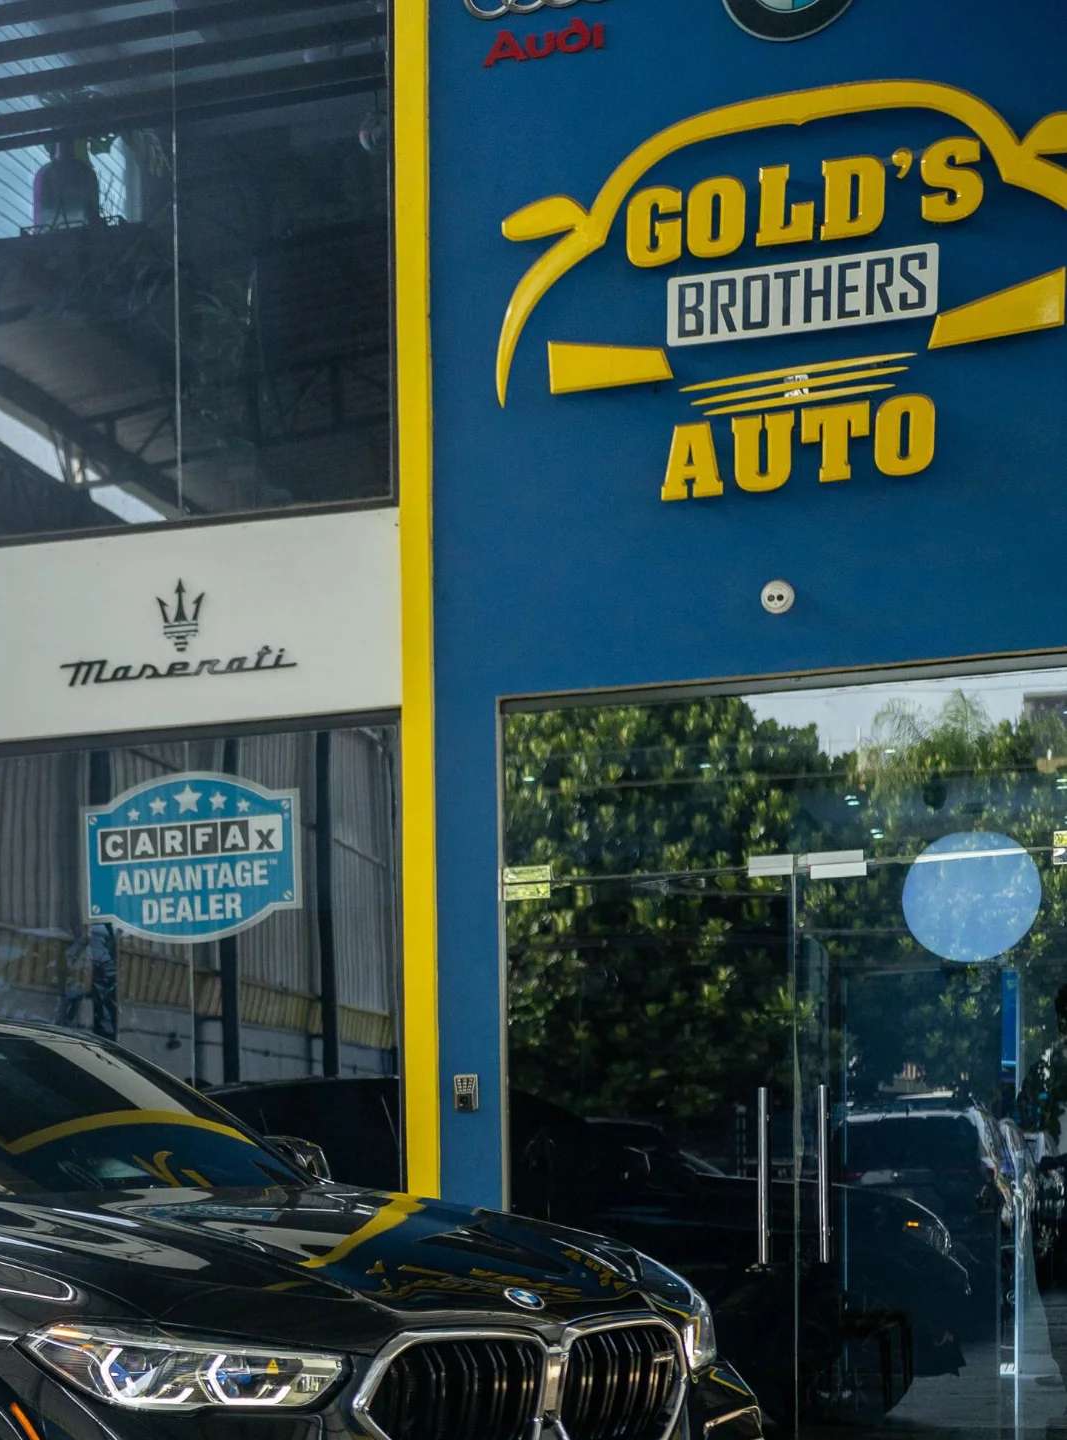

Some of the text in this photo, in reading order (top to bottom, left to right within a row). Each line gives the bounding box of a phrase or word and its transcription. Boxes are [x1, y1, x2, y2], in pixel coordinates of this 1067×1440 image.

[482, 18, 606, 68] Audi
[625, 135, 985, 268] GOLD'S
[676, 251, 929, 340] BROTHERS
[660, 393, 936, 501] AUTO
[59, 645, 298, 688] Maserati
[104, 824, 276, 858] CARFAX
[142, 892, 243, 925] DEALER
